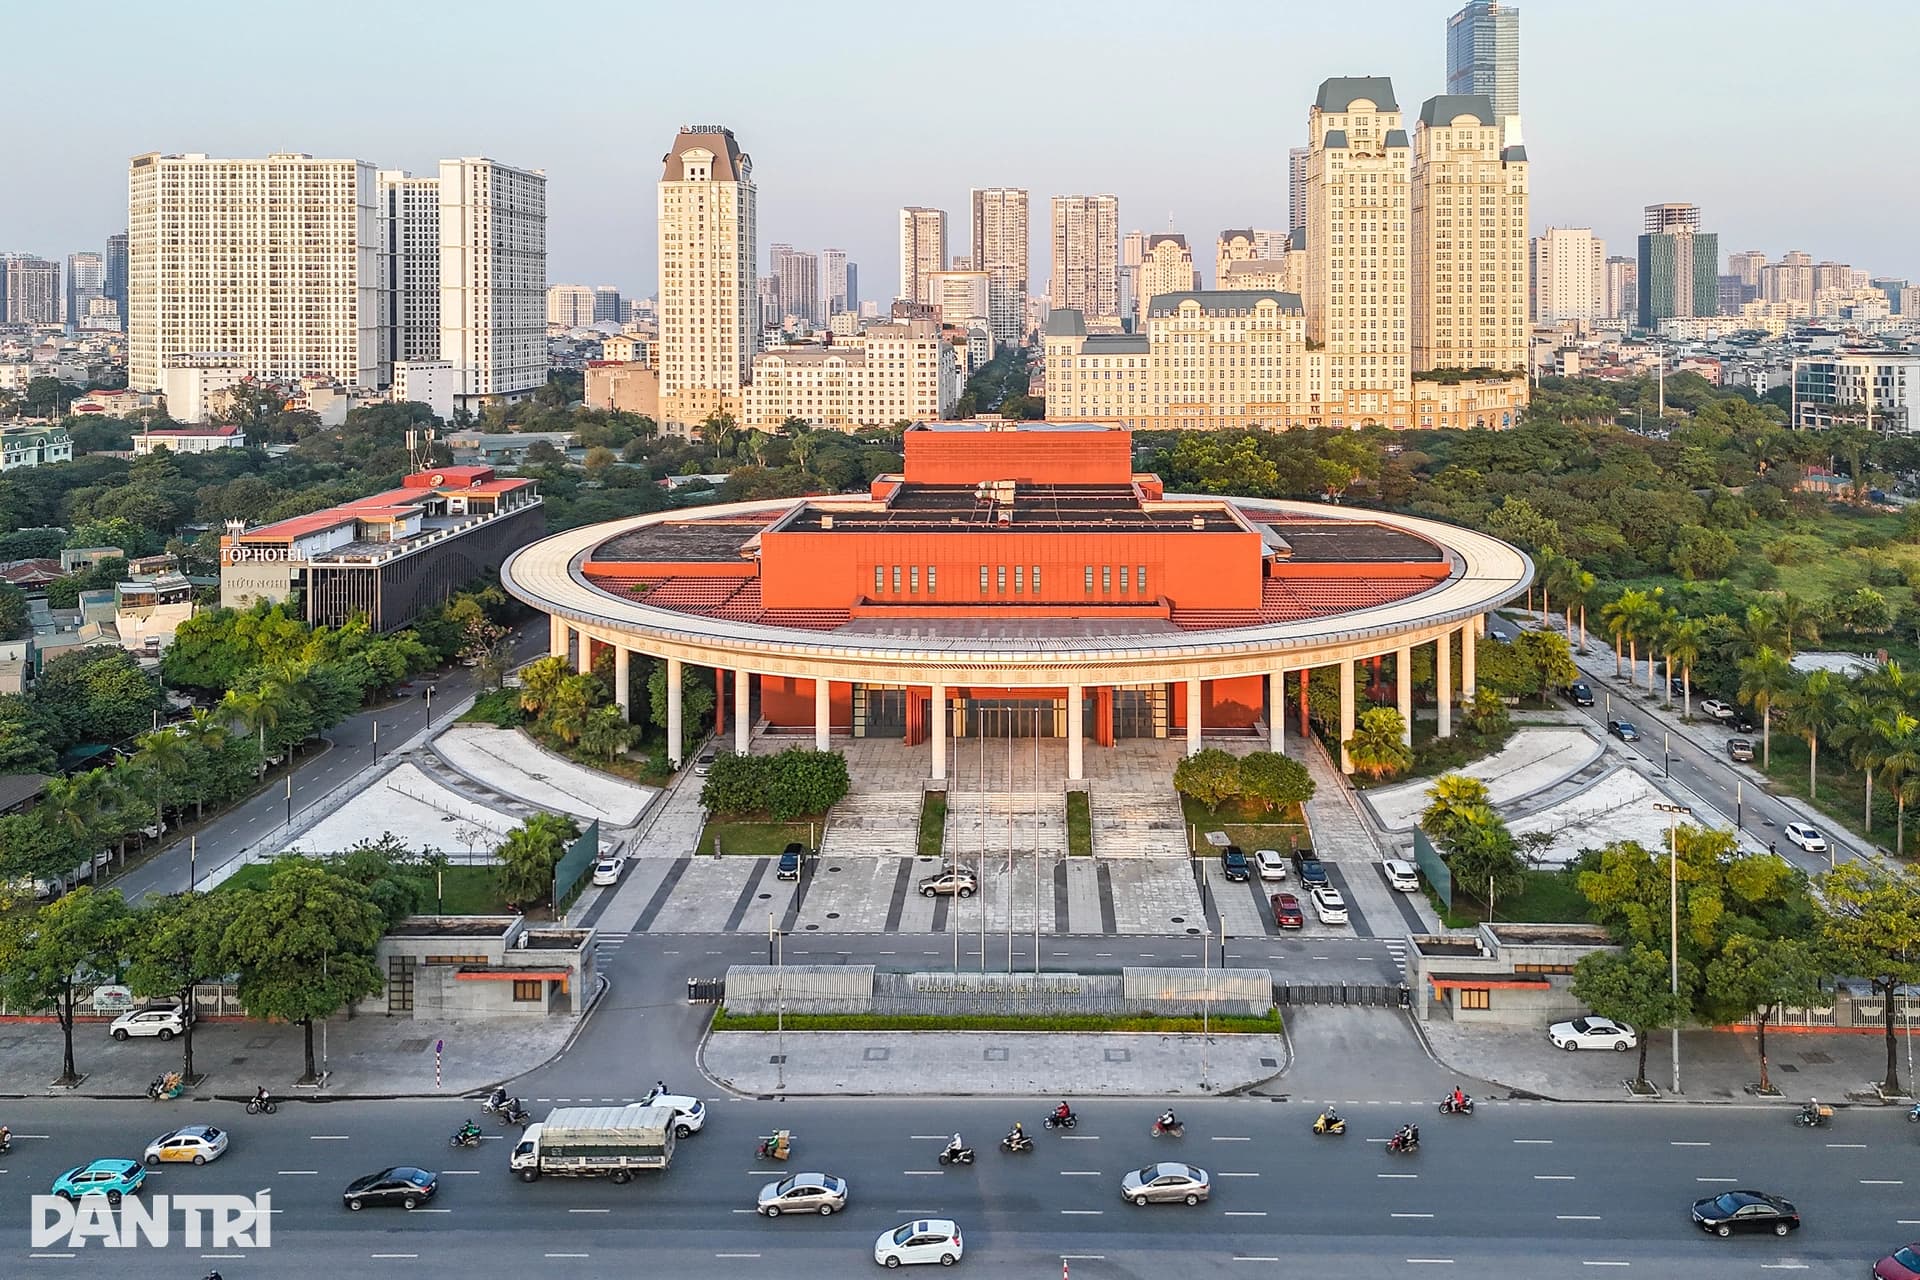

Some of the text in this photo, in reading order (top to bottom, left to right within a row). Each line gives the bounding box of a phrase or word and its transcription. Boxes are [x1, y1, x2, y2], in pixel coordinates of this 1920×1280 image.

[691, 125, 723, 133] SUDICO
[220, 548, 306, 562] TOP HOTEL
